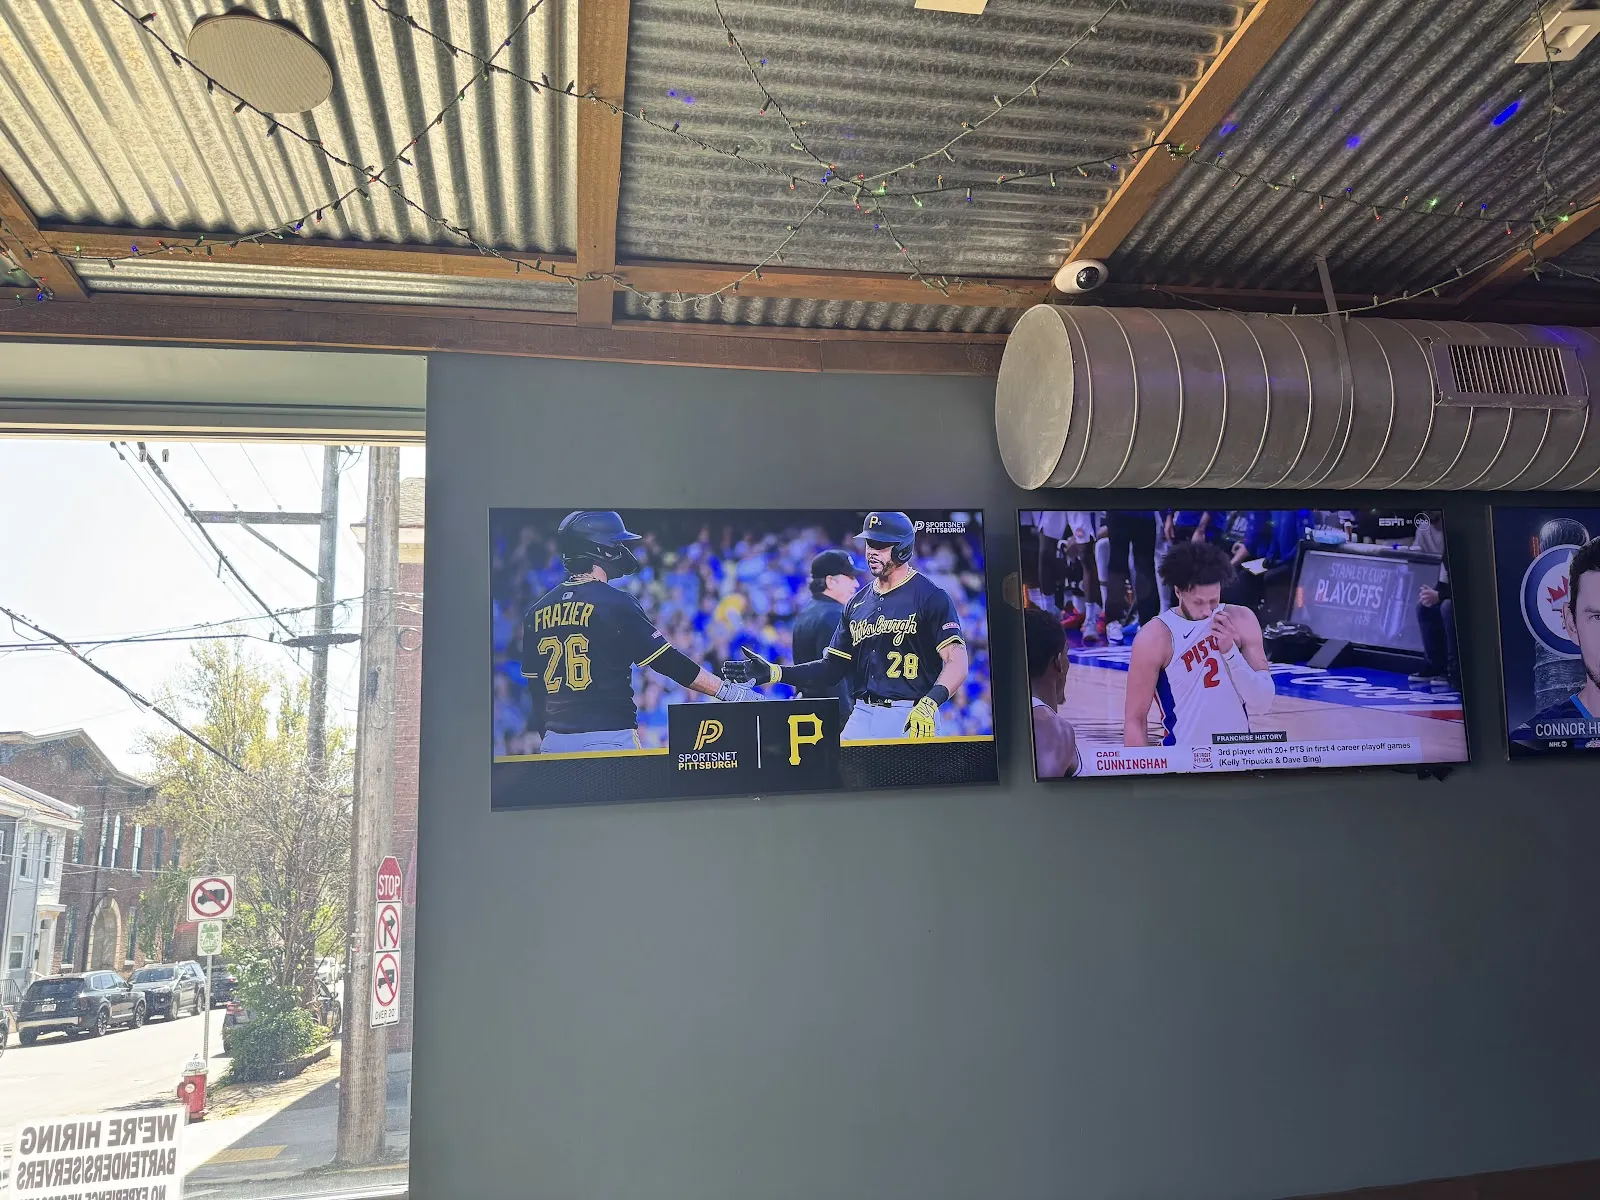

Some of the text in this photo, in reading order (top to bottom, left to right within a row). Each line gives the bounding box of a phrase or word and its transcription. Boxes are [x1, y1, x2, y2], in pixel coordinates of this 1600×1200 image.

[1379, 517, 1404, 526] ESPN
[1330, 562, 1386, 583] STANLEY CUP
[1314, 578, 1383, 609] PLAYOFFS
[534, 601, 595, 633] FRAZIER
[848, 612, 918, 647] Pittsburgh
[537, 633, 593, 694] 26
[886, 651, 919, 680] 28
[1203, 657, 1221, 688] 2
[787, 712, 824, 765] P
[1535, 722, 1586, 737] CONNOR
[678, 751, 738, 763] SPORTSNET
[1218, 742, 1411, 757] 3rd player with 20+ PTS in first 4 career playoff games
[678, 760, 738, 771] PITTSBURGH
[1096, 757, 1168, 771] CUNNINGHAM
[1219, 758, 1240, 767] (Kelly
[1242, 757, 1274, 766] Tripucka
[1282, 756, 1301, 764] Dave
[1303, 755, 1322, 764] Bing)
[378, 875, 401, 896] STOP
[375, 1009, 387, 1020] OVER
